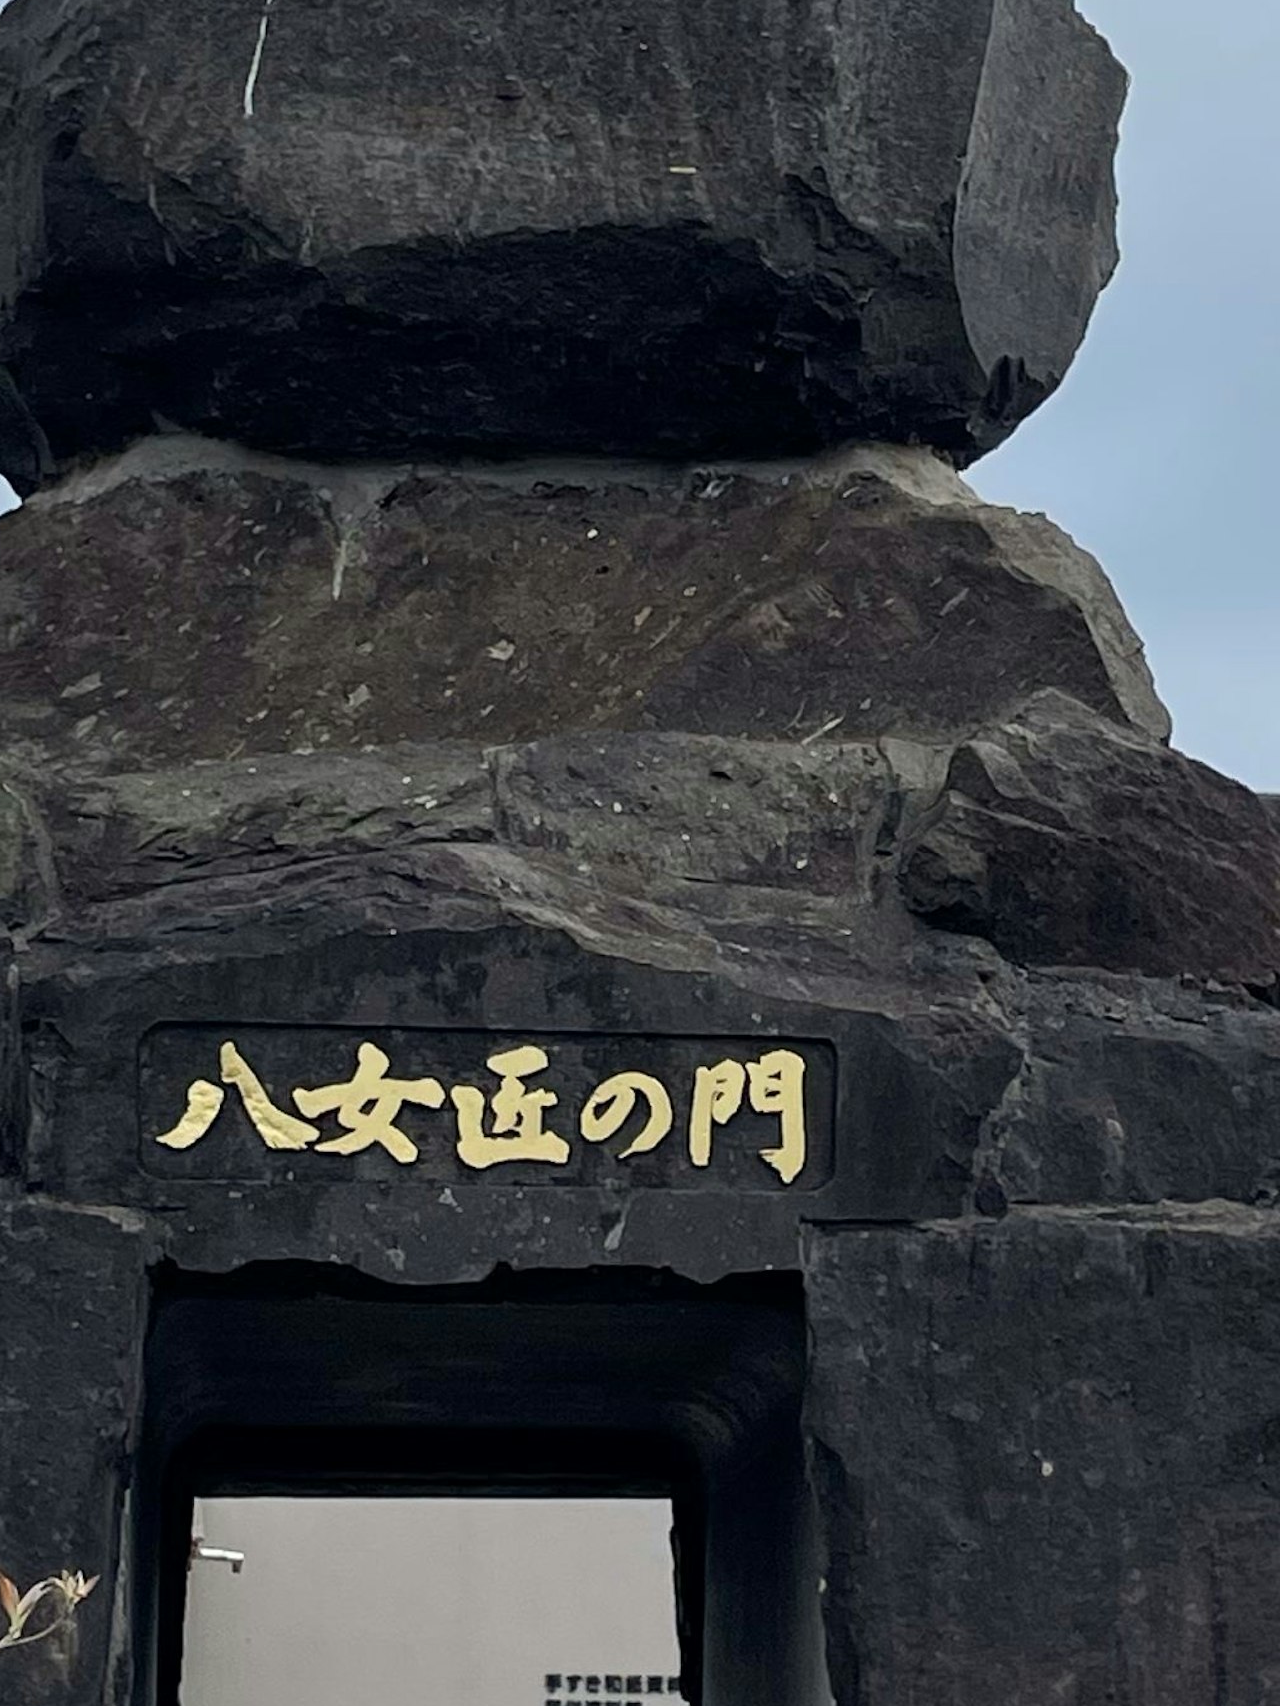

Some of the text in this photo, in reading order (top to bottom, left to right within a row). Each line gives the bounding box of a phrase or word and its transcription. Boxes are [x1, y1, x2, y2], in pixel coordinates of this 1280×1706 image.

[155, 1040, 806, 1185] 八女匠の門
